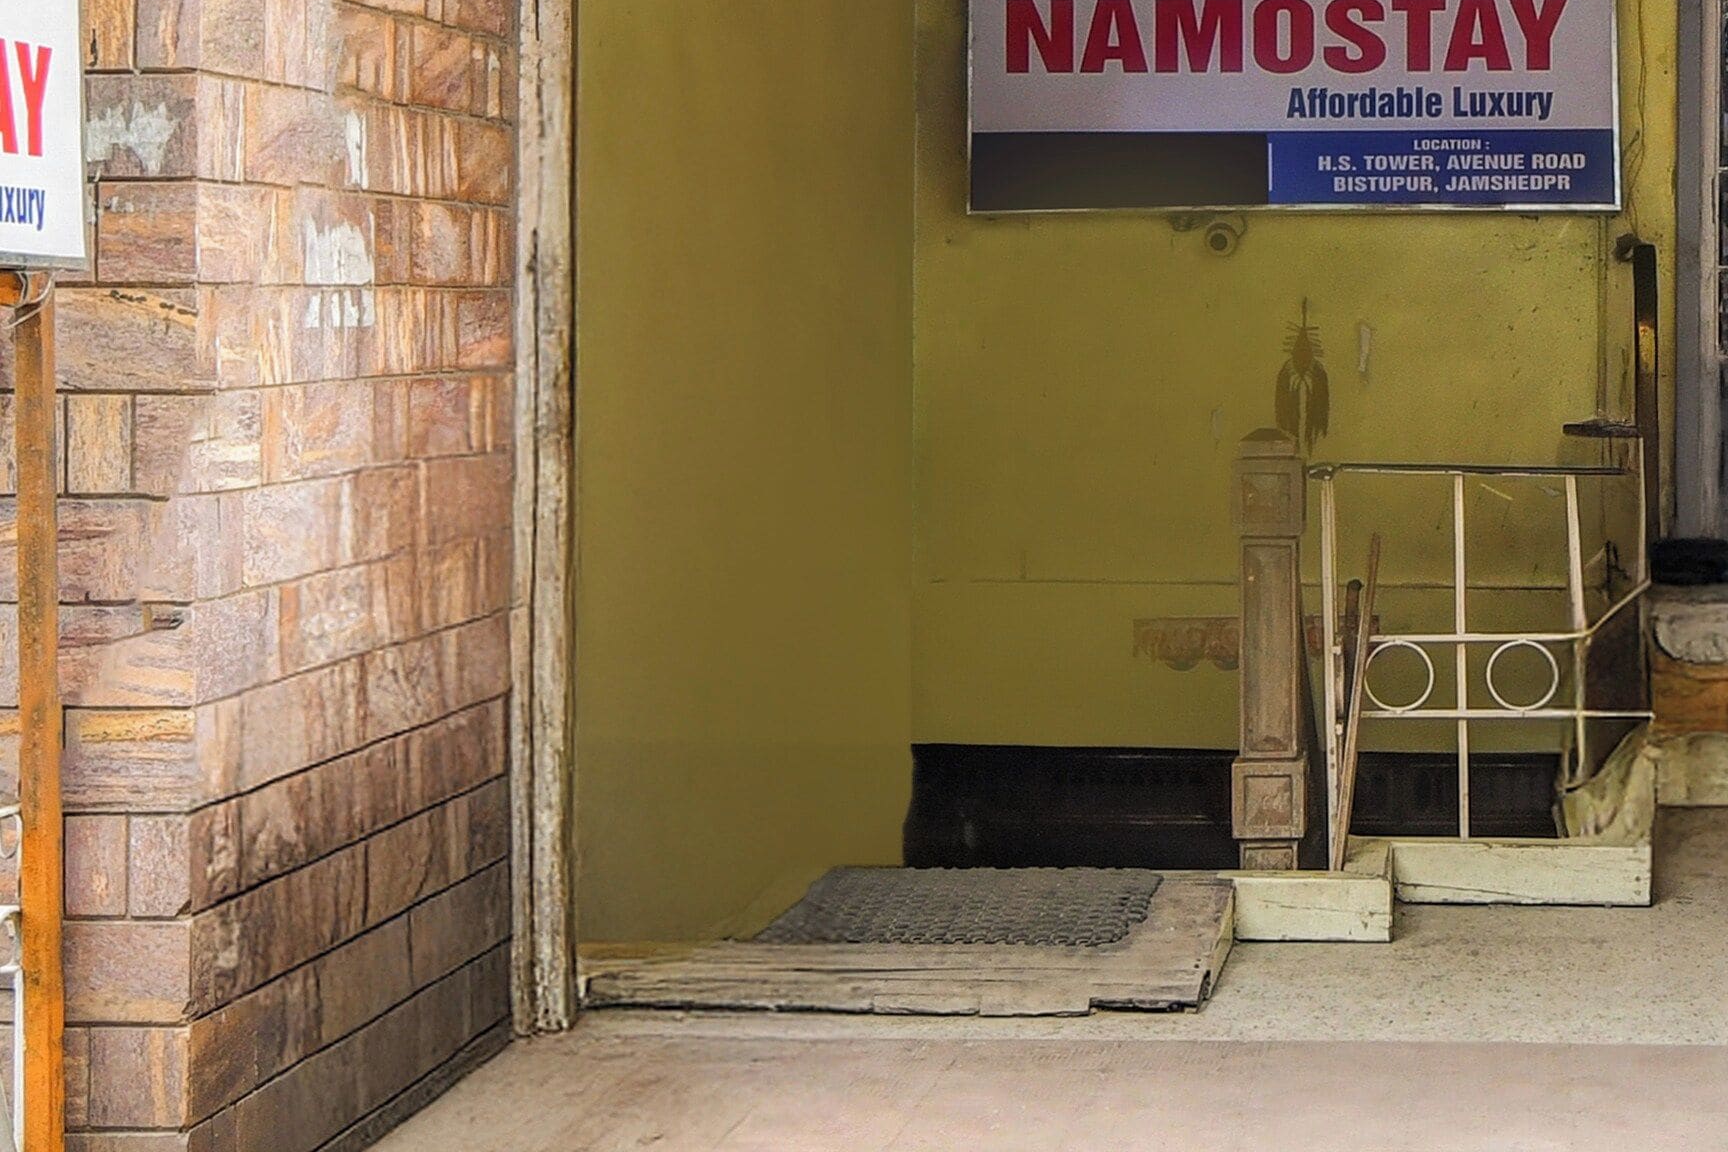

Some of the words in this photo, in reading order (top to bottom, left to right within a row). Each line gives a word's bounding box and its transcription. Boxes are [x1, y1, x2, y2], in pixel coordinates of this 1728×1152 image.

[1286, 86, 1443, 119] Affordable
[1452, 86, 1554, 121] Luxury
[1413, 139, 1482, 151] LOCATION
[1318, 155, 1357, 172] H.S.
[1363, 155, 1441, 173] TOWER,
[1446, 154, 1526, 171] AVENUE
[1531, 153, 1587, 170] ROAD
[1333, 176, 1440, 194] BISTUPUR,
[1445, 174, 1572, 192] JAMSHEDPR
